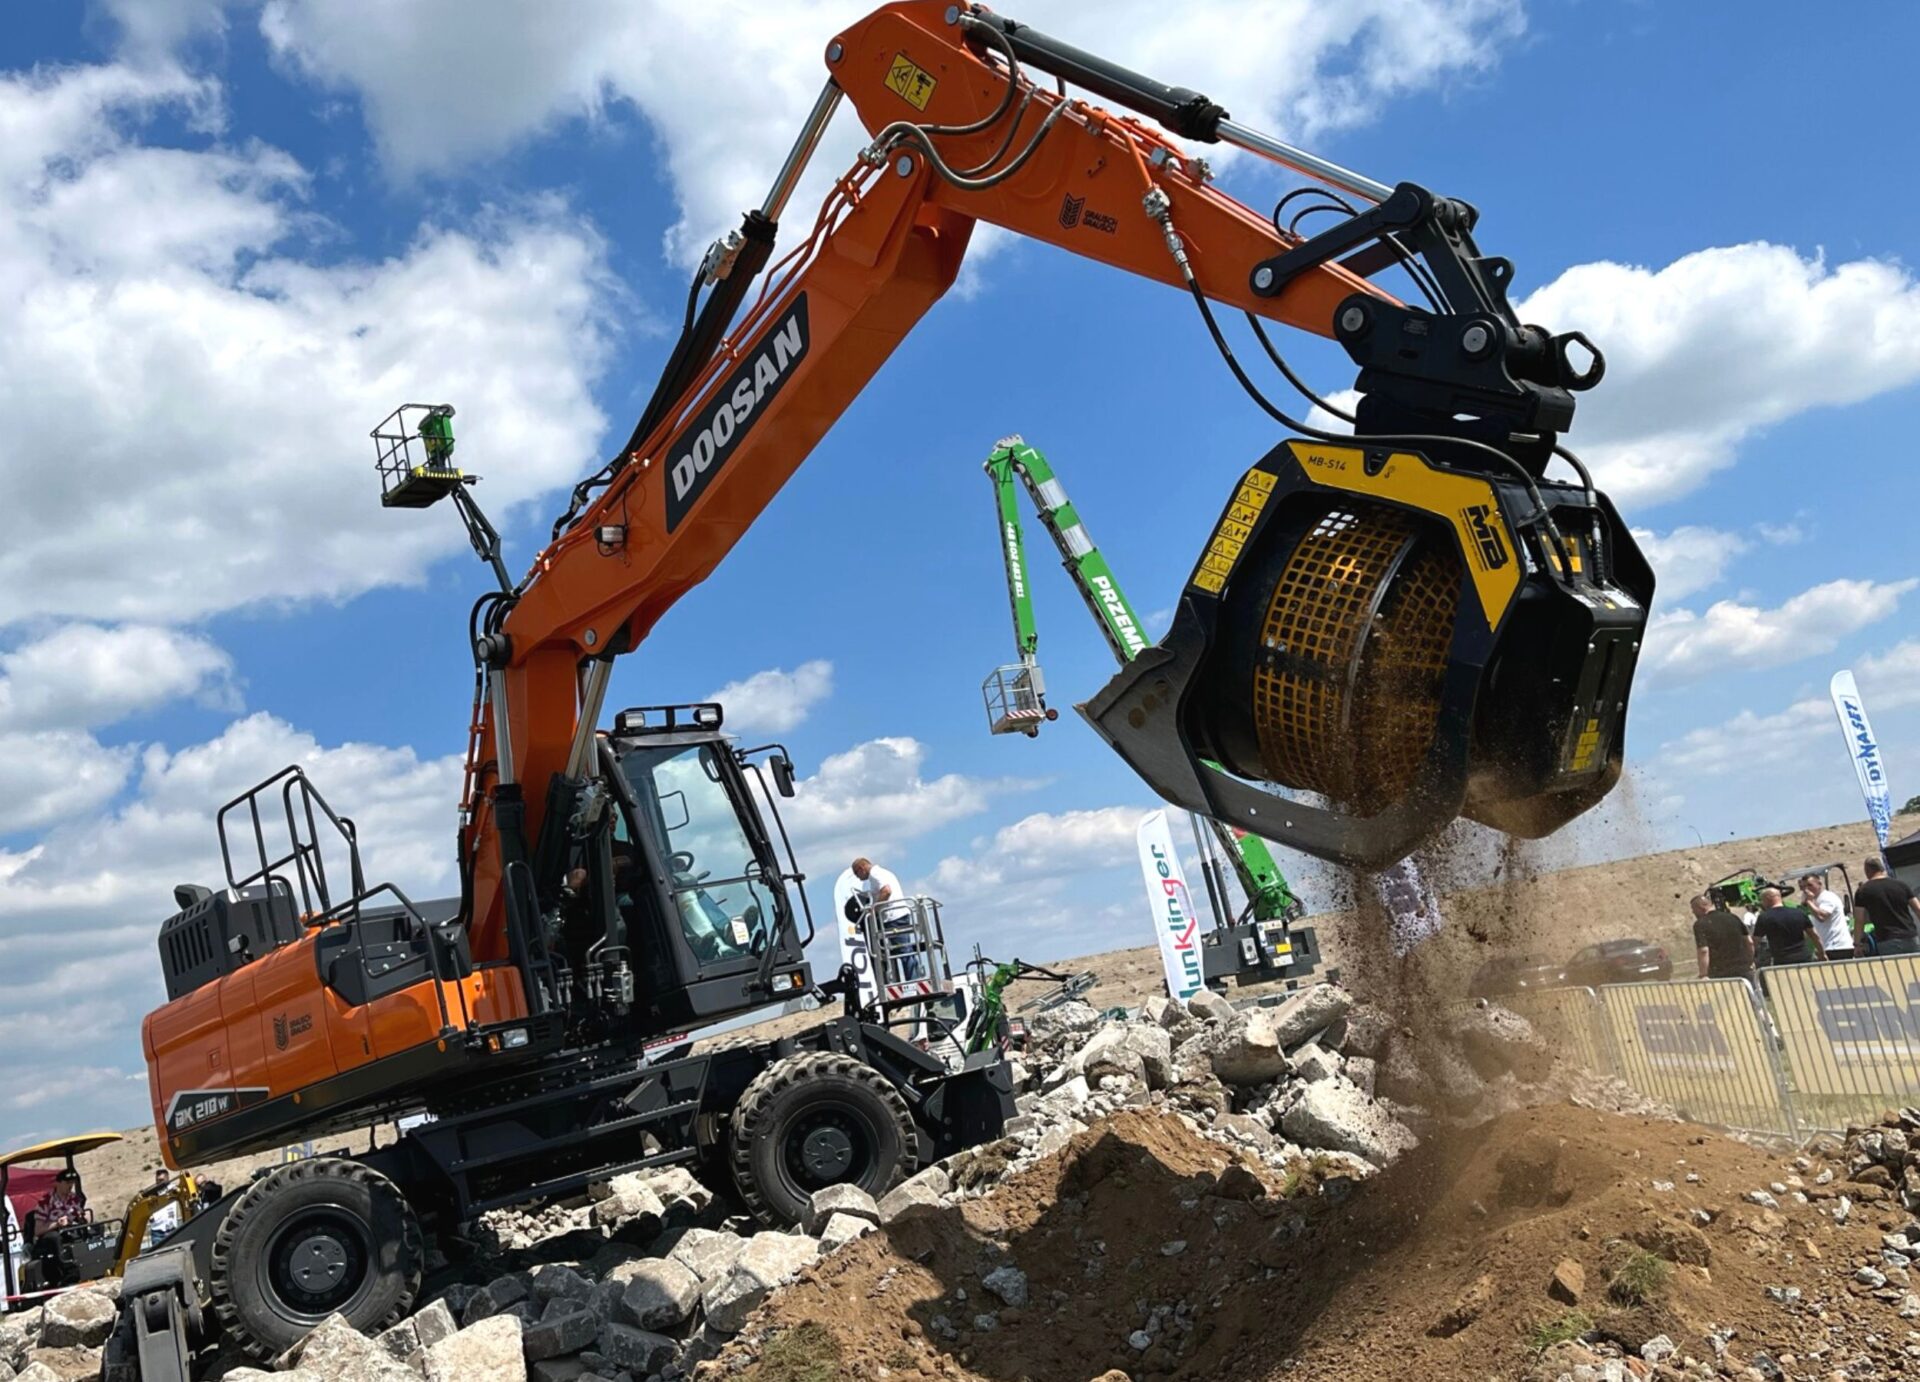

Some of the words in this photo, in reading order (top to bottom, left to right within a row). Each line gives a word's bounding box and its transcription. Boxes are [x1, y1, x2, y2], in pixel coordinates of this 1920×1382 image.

[671, 314, 802, 501] DOOSAN
[1307, 455, 1347, 471] MB-S14
[1466, 504, 1509, 570] MB
[1843, 700, 1881, 781] DYNASET
[195, 1097, 217, 1122] 210
